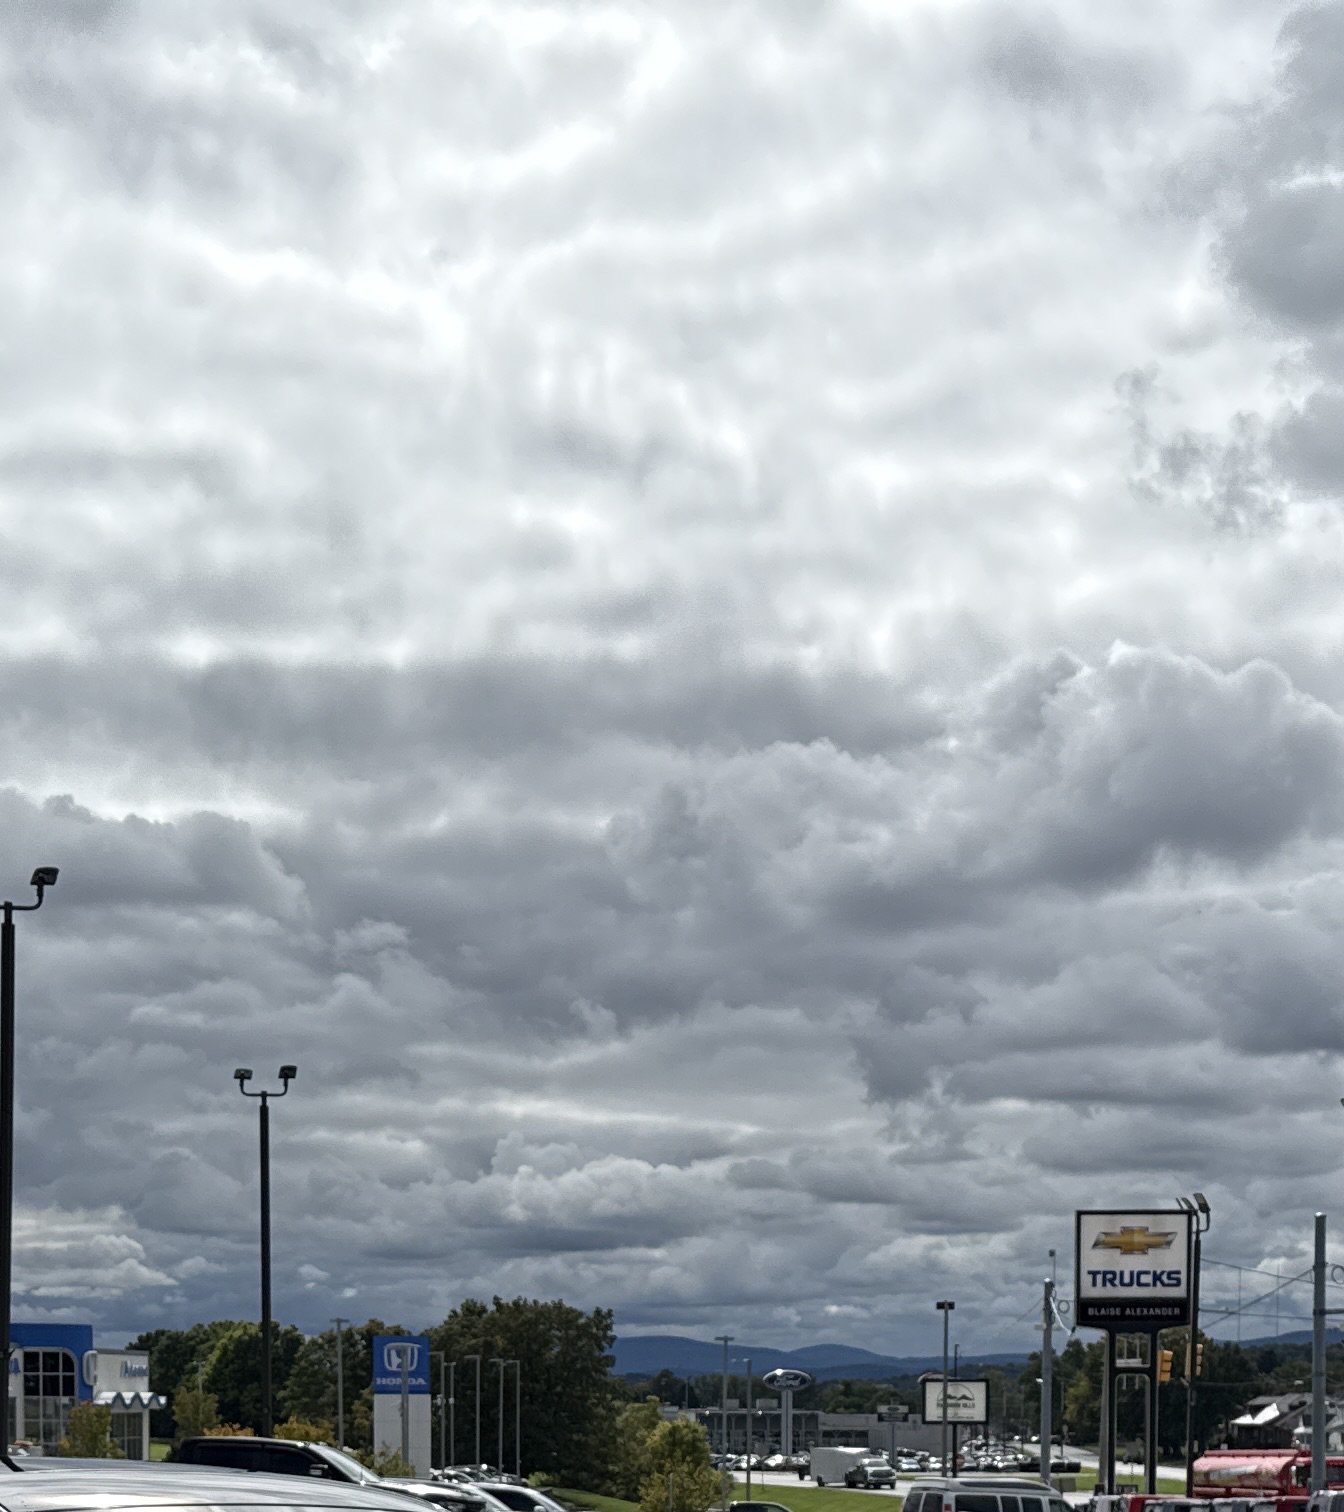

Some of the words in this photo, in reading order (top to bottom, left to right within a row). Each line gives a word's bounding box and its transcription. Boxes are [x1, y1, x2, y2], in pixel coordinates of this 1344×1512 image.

[1087, 1269, 1182, 1288] TRUCKS
[1087, 1307, 1122, 1317] BLAISE
[1124, 1307, 1181, 1317] ALEXANDER
